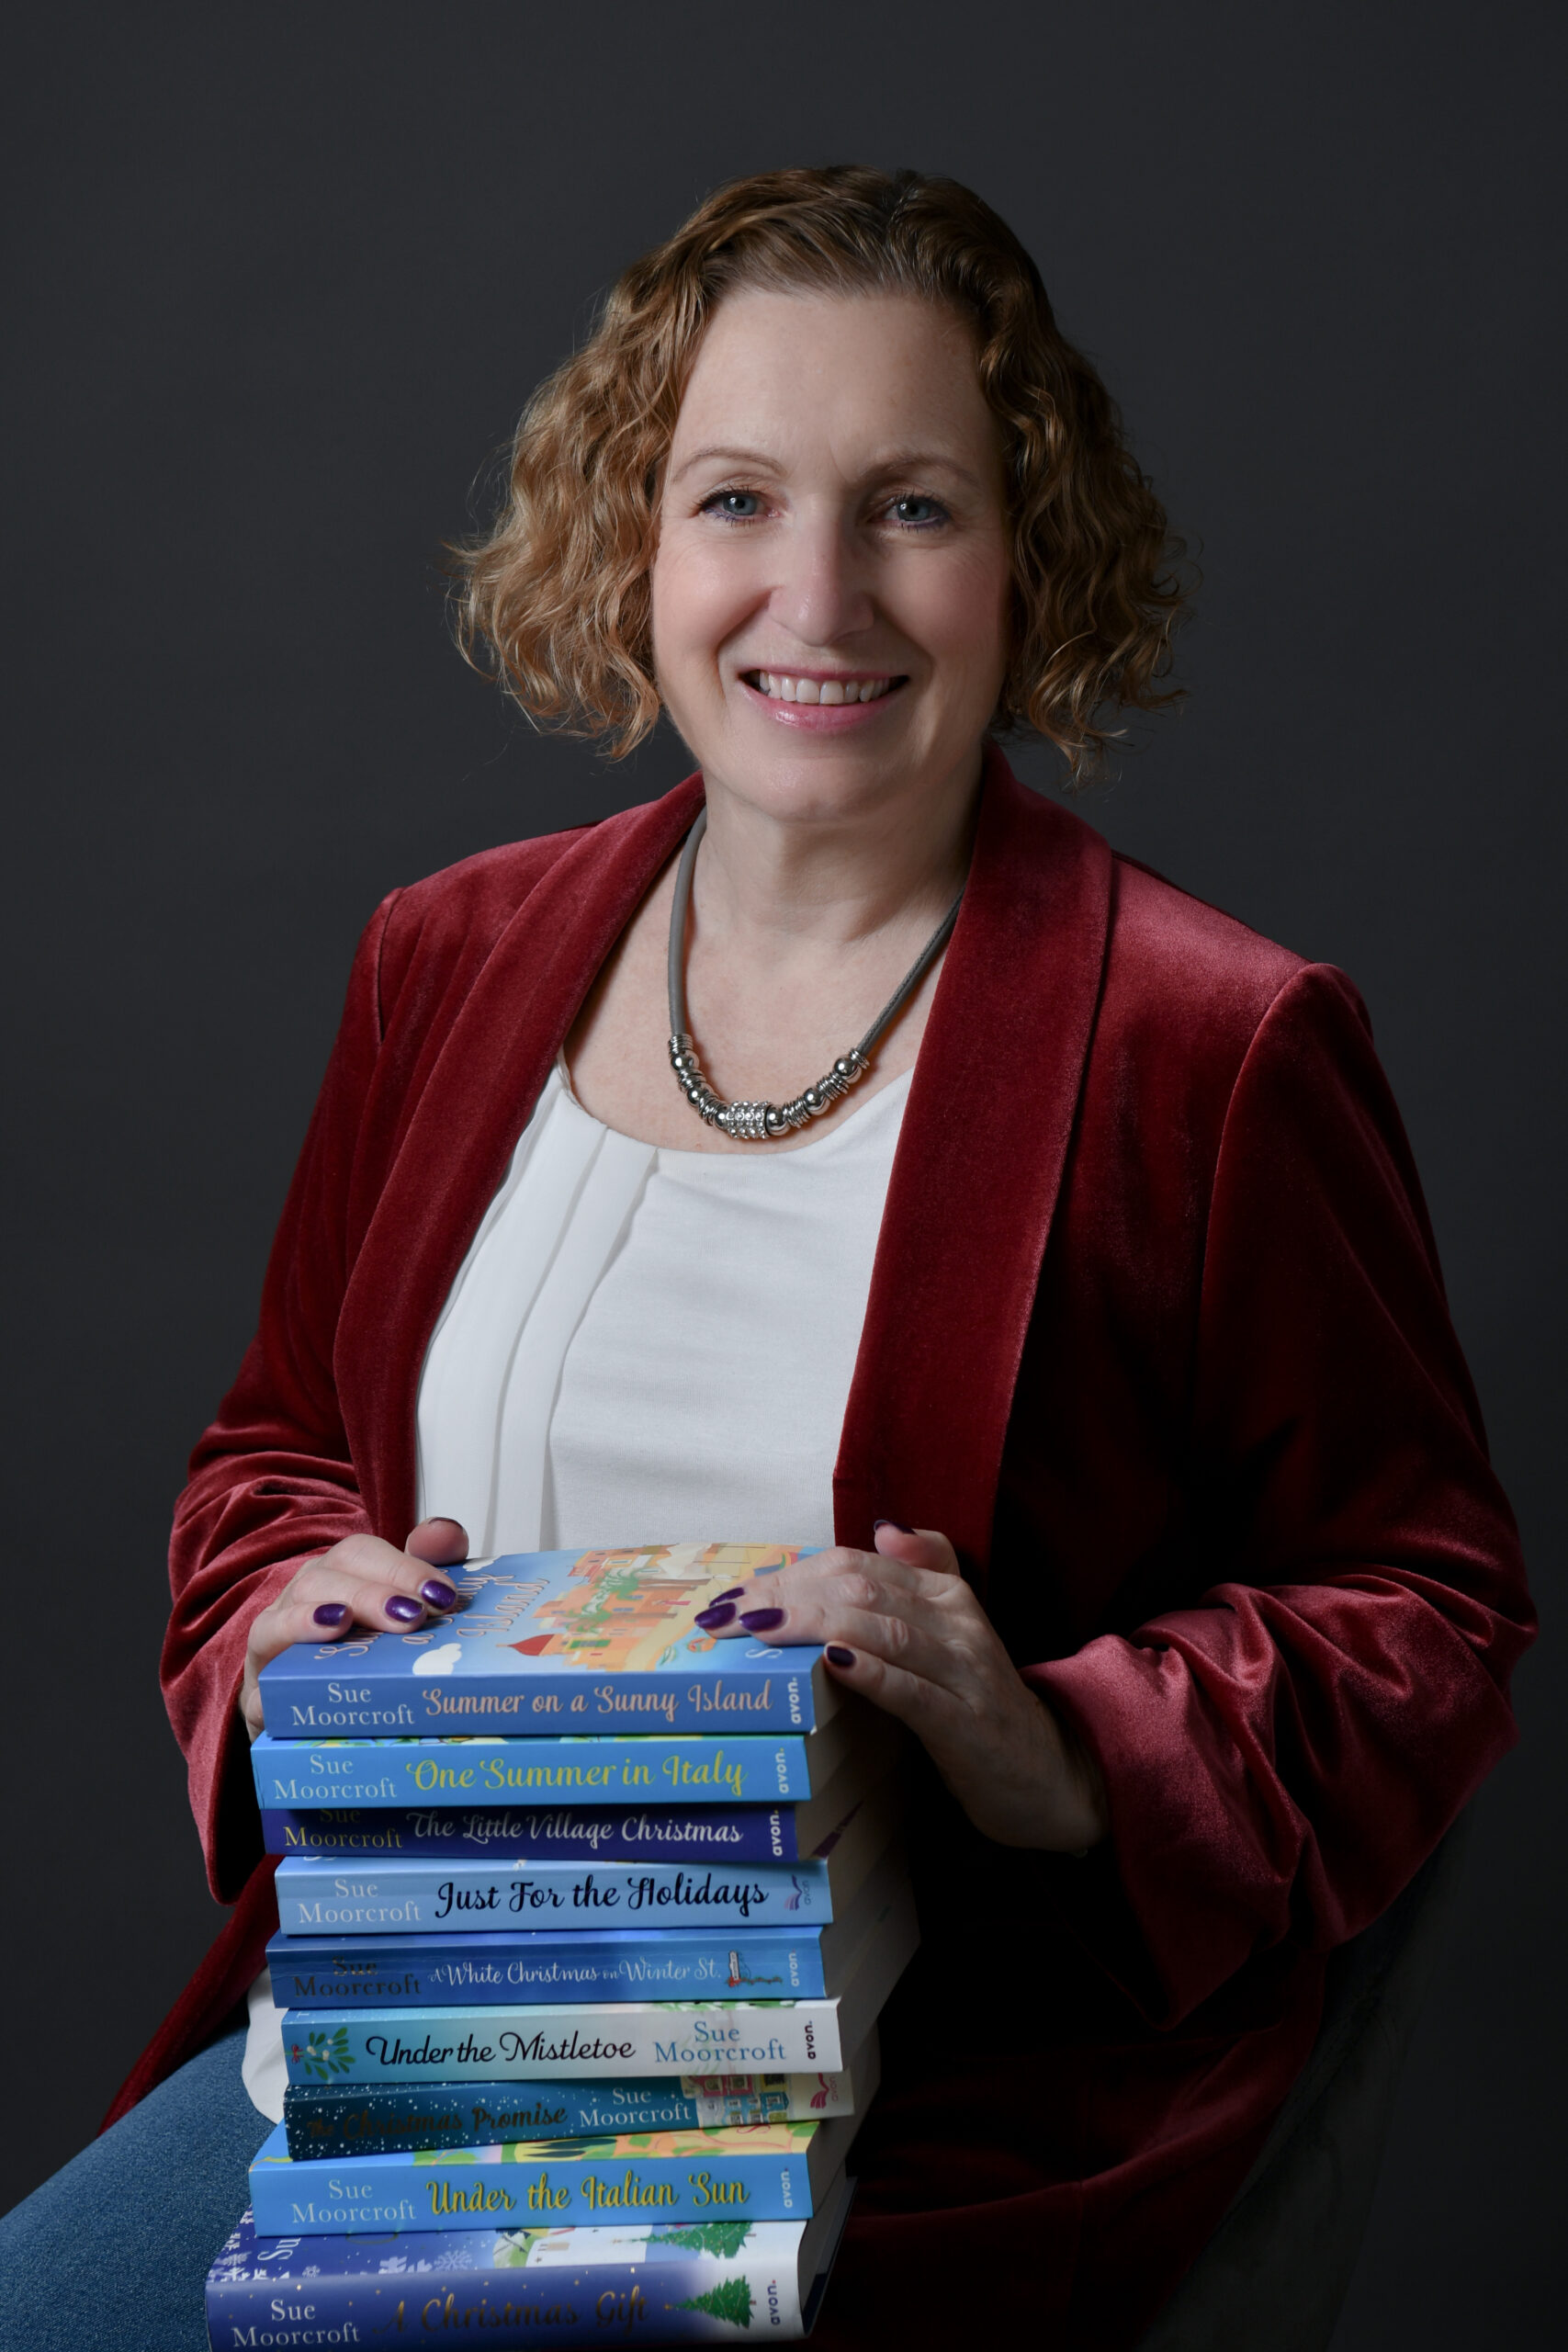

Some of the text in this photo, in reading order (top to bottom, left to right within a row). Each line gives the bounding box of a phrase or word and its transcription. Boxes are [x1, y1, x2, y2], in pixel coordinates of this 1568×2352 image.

[456, 1577, 549, 1637] Island
[328, 1682, 371, 1702] Sue
[423, 1679, 773, 1723] Summer on a Sunny Island
[290, 1704, 415, 1725] Moorcroft
[310, 1754, 354, 1774] Sue
[406, 1750, 749, 1796] One Summer in Italy
[273, 1778, 397, 1800] Moorcroft
[320, 1808, 360, 1823] Sue
[283, 1826, 403, 1849] Moorcroft
[406, 1810, 744, 1849] The Little Village Christmas
[334, 1878, 378, 1897] Sue
[434, 1871, 769, 1918] Just For the Holidays
[298, 1901, 421, 1923] Moorcroft
[332, 1955, 378, 1975] Sue
[442, 1961, 504, 1986] White
[507, 1960, 598, 1984] Christmas
[619, 1956, 691, 1982] Winter
[694, 1957, 721, 1980] St.
[293, 1974, 422, 1997] Moorcroft
[694, 2022, 739, 2042] Sue
[366, 2030, 637, 2064] Under the Mistletoe
[654, 2039, 786, 2063] Moorcroft
[613, 2087, 651, 2105] Sue
[307, 2102, 568, 2141] The Christmas Promise
[581, 2103, 691, 2127] Moorcroft
[329, 2179, 373, 2199] Sue
[426, 2169, 749, 2215] Under the Italian Sun
[291, 2199, 416, 2222] Moorcroft
[257, 2237, 300, 2260] Su
[271, 2299, 315, 2321] Sue
[372, 2285, 649, 2338] A Christmas Gift
[231, 2322, 360, 2347] Moorcroft
